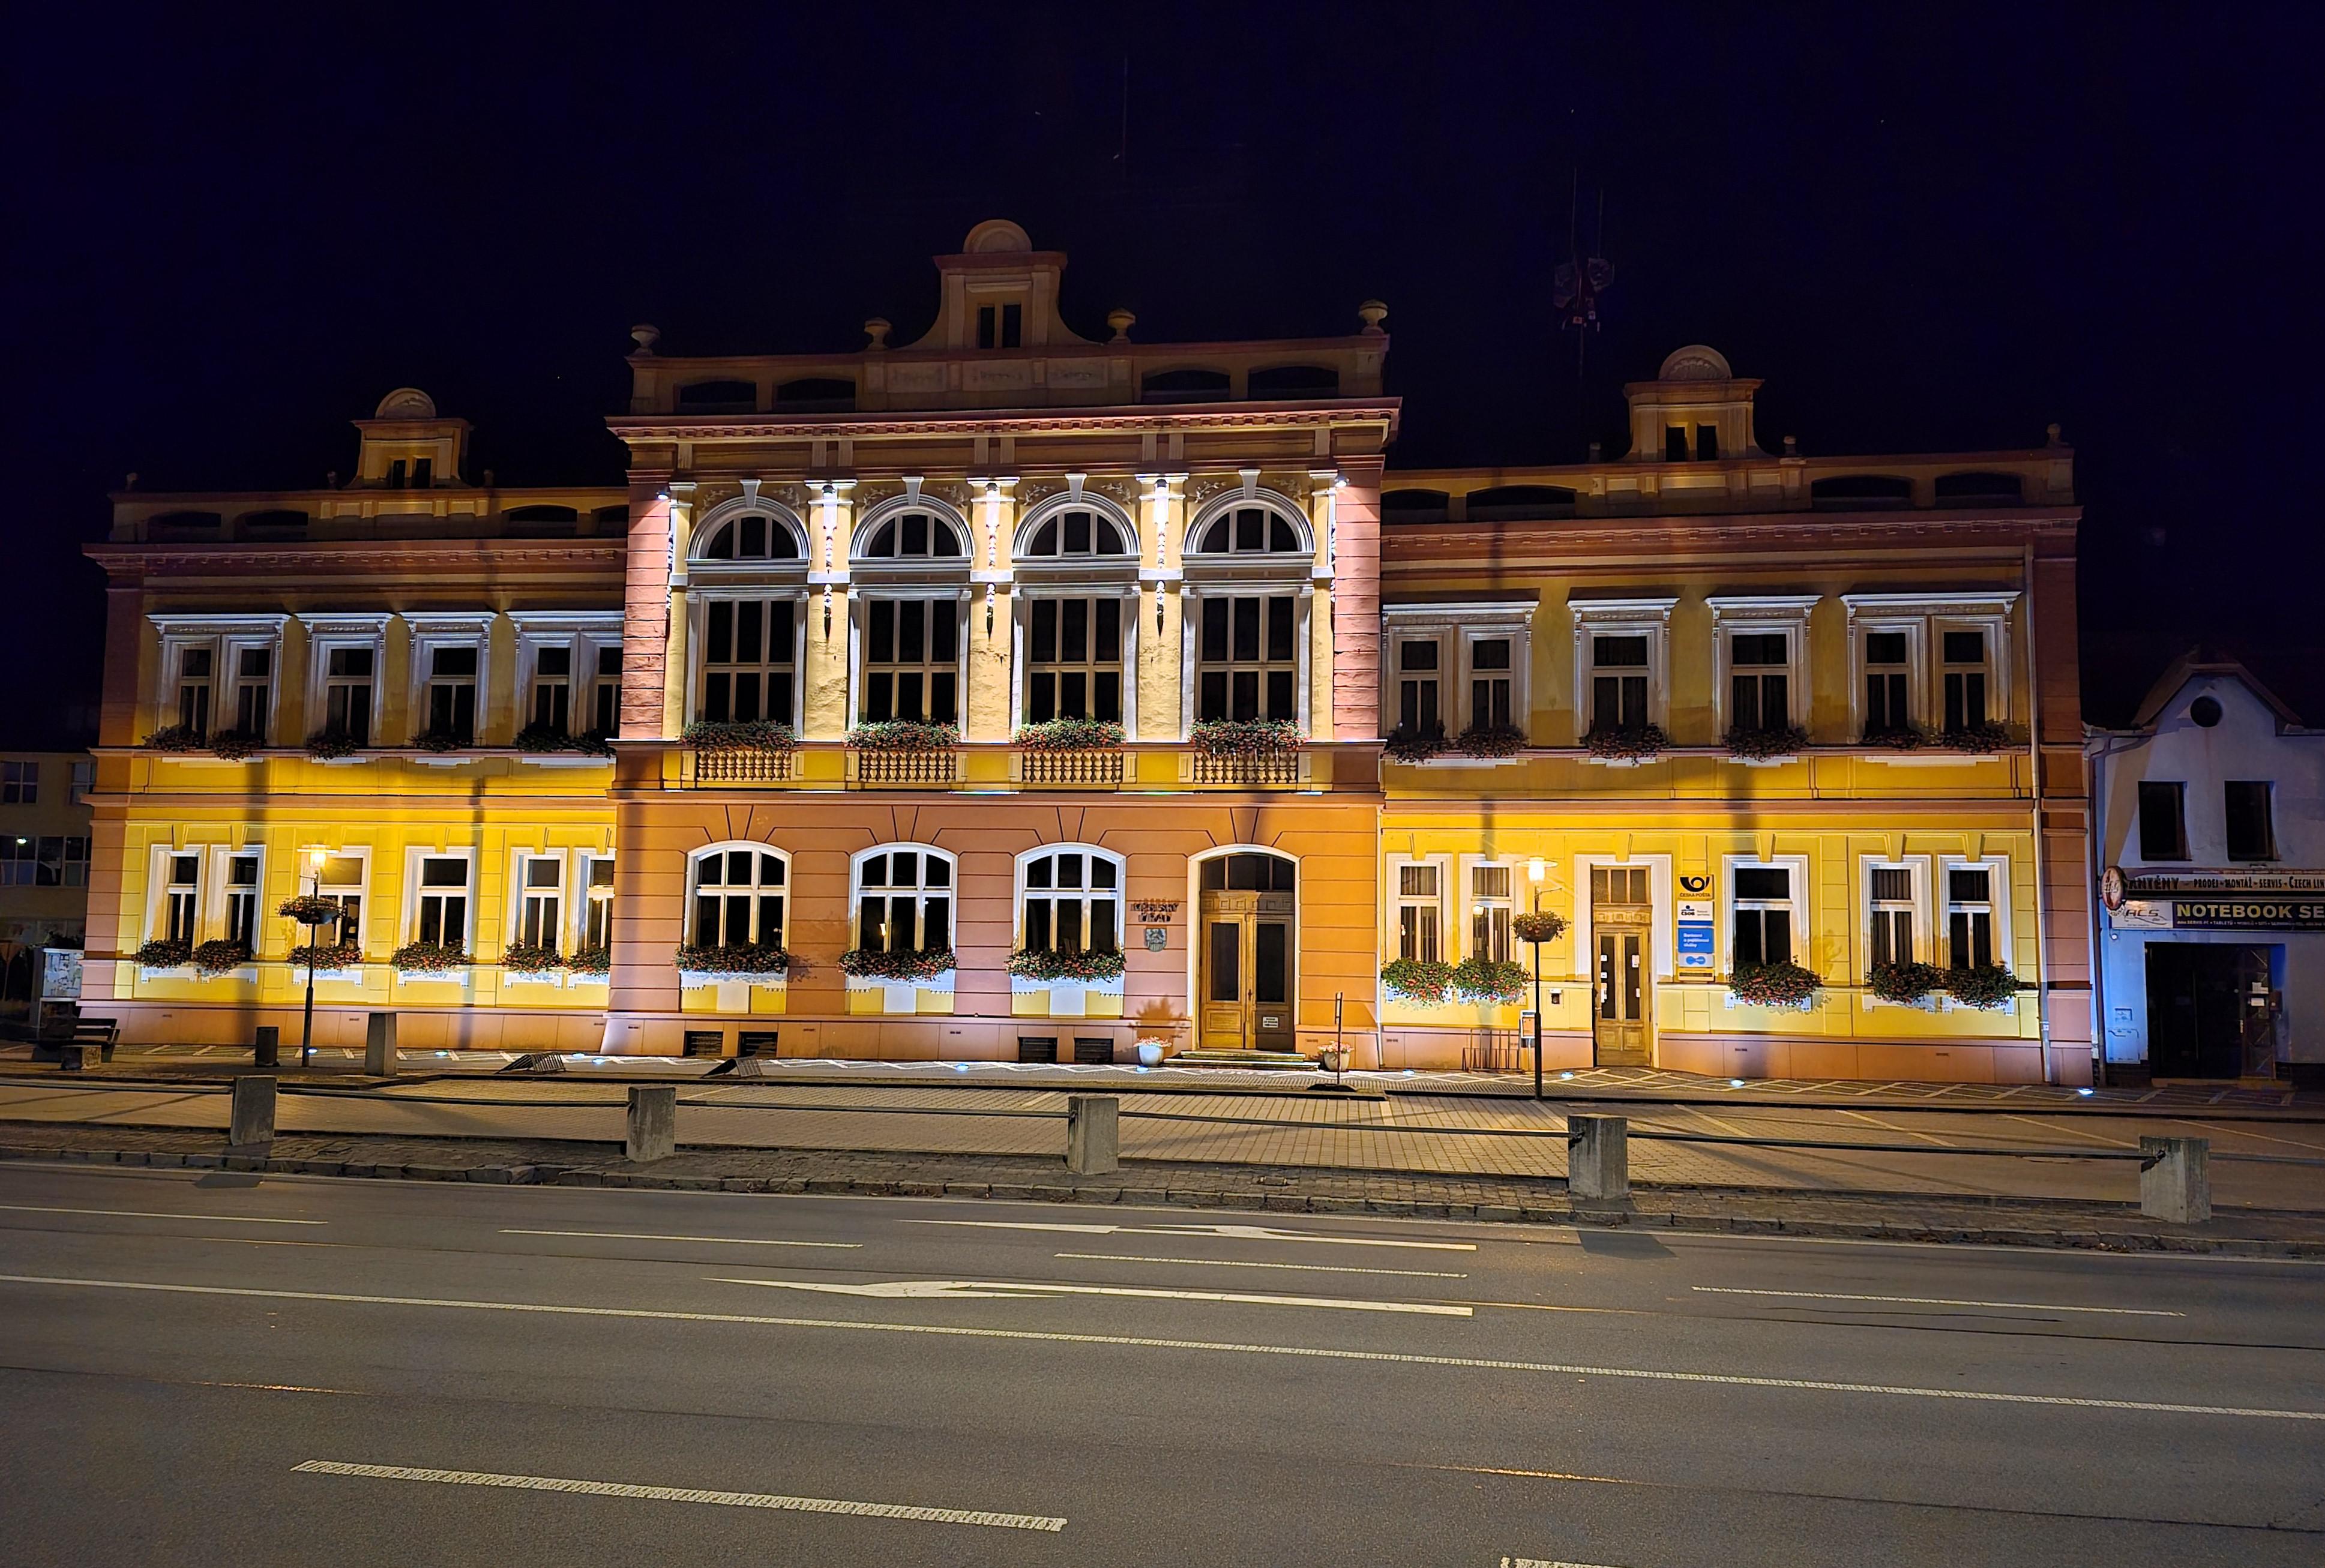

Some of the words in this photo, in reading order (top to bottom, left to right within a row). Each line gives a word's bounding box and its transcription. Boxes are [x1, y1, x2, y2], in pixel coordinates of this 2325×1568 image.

[2129, 876, 2179, 889] ANTÉNY
[2194, 878, 2219, 888] PRODEJ
[2224, 876, 2252, 888] MONTÁŽ
[2259, 878, 2282, 889] SERVIS
[2177, 904, 2293, 919] NOTEBOOK
